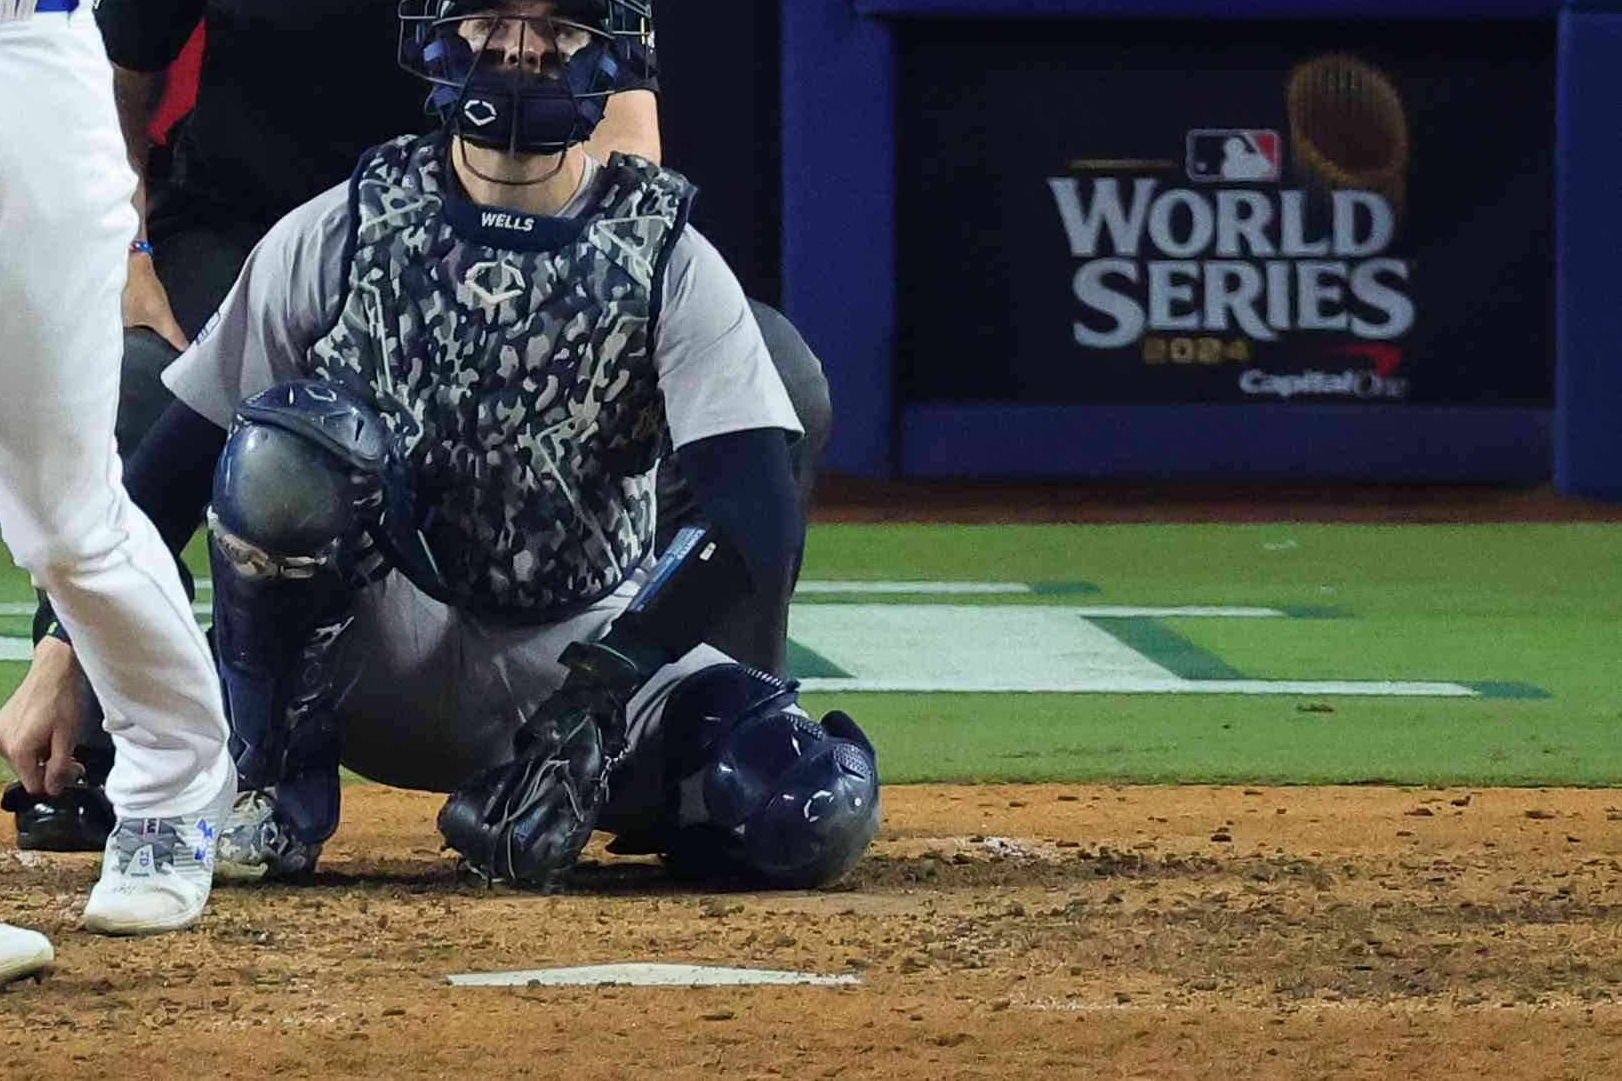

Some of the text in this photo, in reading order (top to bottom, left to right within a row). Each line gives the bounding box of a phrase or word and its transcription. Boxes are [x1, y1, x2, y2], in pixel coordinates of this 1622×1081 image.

[480, 211, 535, 232] WELLS
[1048, 175, 1396, 259] WORLD
[1070, 256, 1416, 349] SERIES
